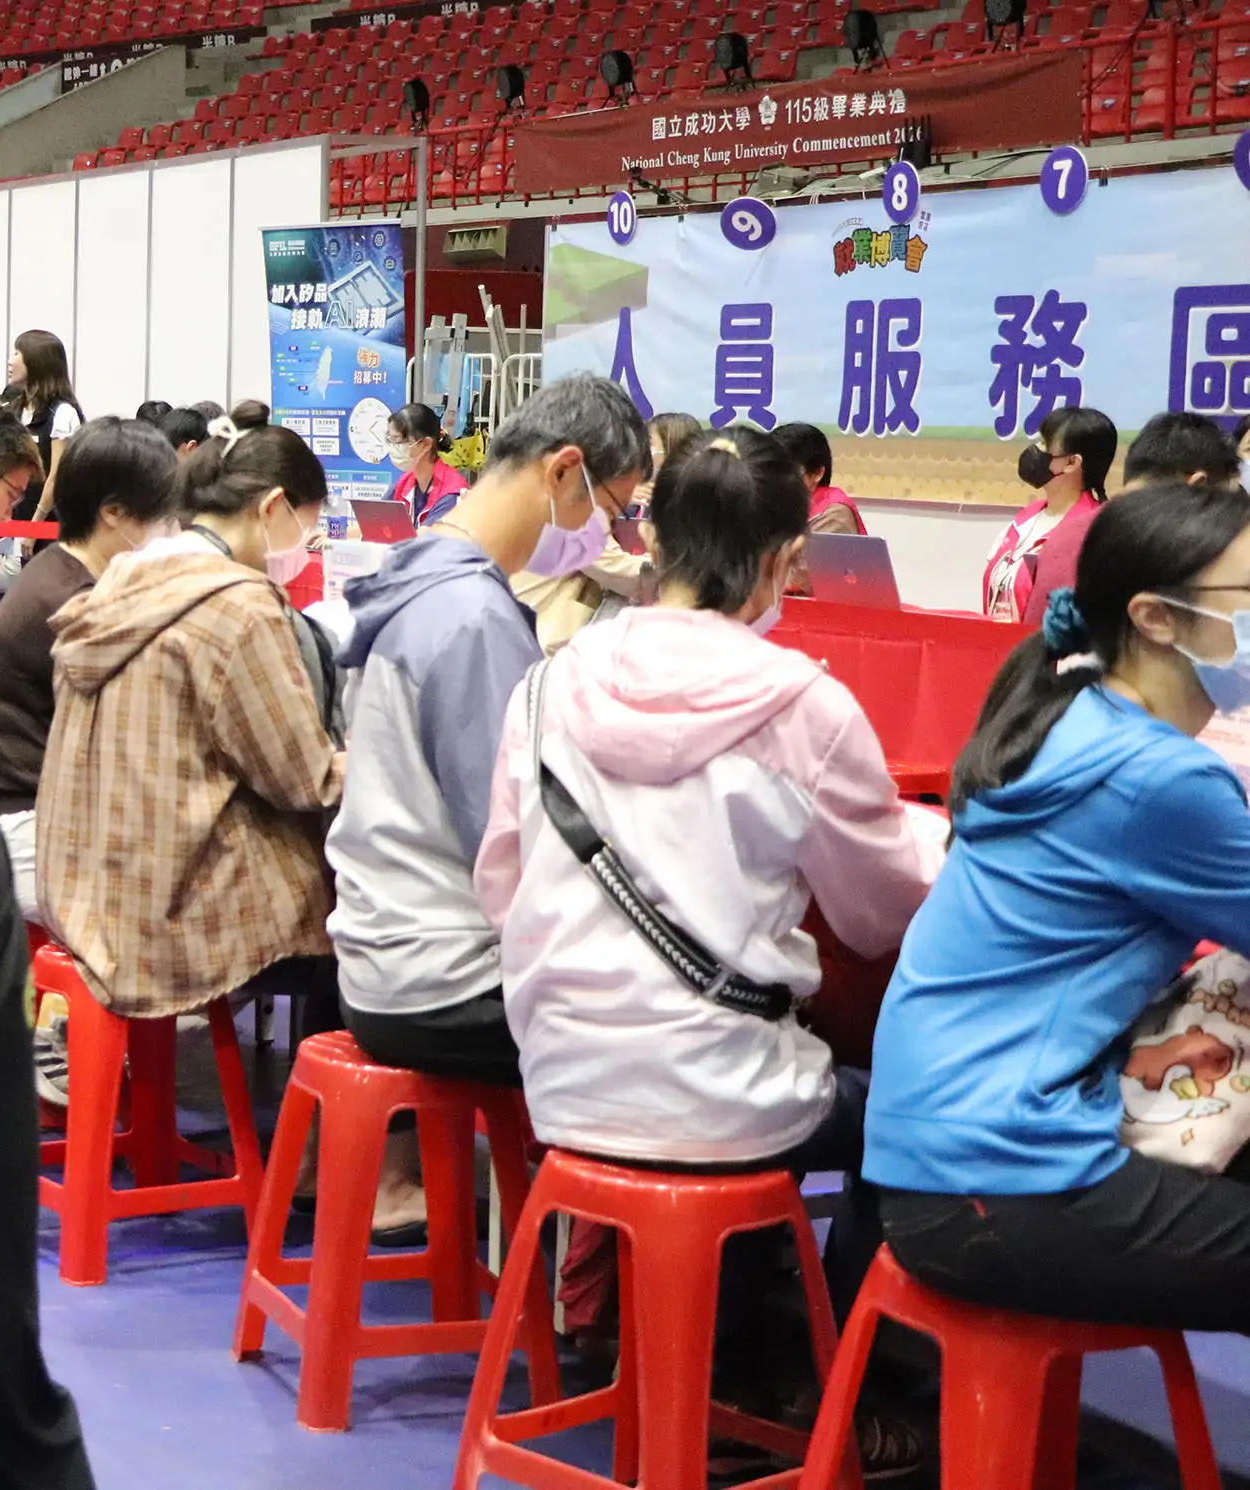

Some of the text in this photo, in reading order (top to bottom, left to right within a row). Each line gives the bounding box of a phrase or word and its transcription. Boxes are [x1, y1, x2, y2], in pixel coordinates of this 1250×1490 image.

[651, 88, 906, 141] 國立成功大學 115級畢業典禮
[621, 154, 664, 172] National
[667, 149, 700, 170] Cheng
[703, 146, 731, 165] Kung
[734, 141, 788, 159] University
[792, 131, 891, 154] Commencement
[892, 172, 908, 212] 8
[1053, 159, 1073, 199] 7
[610, 202, 631, 234] 10
[731, 210, 762, 241] 9
[271, 283, 328, 304] 加入矽品
[608, 284, 1250, 438] 人員服務區
